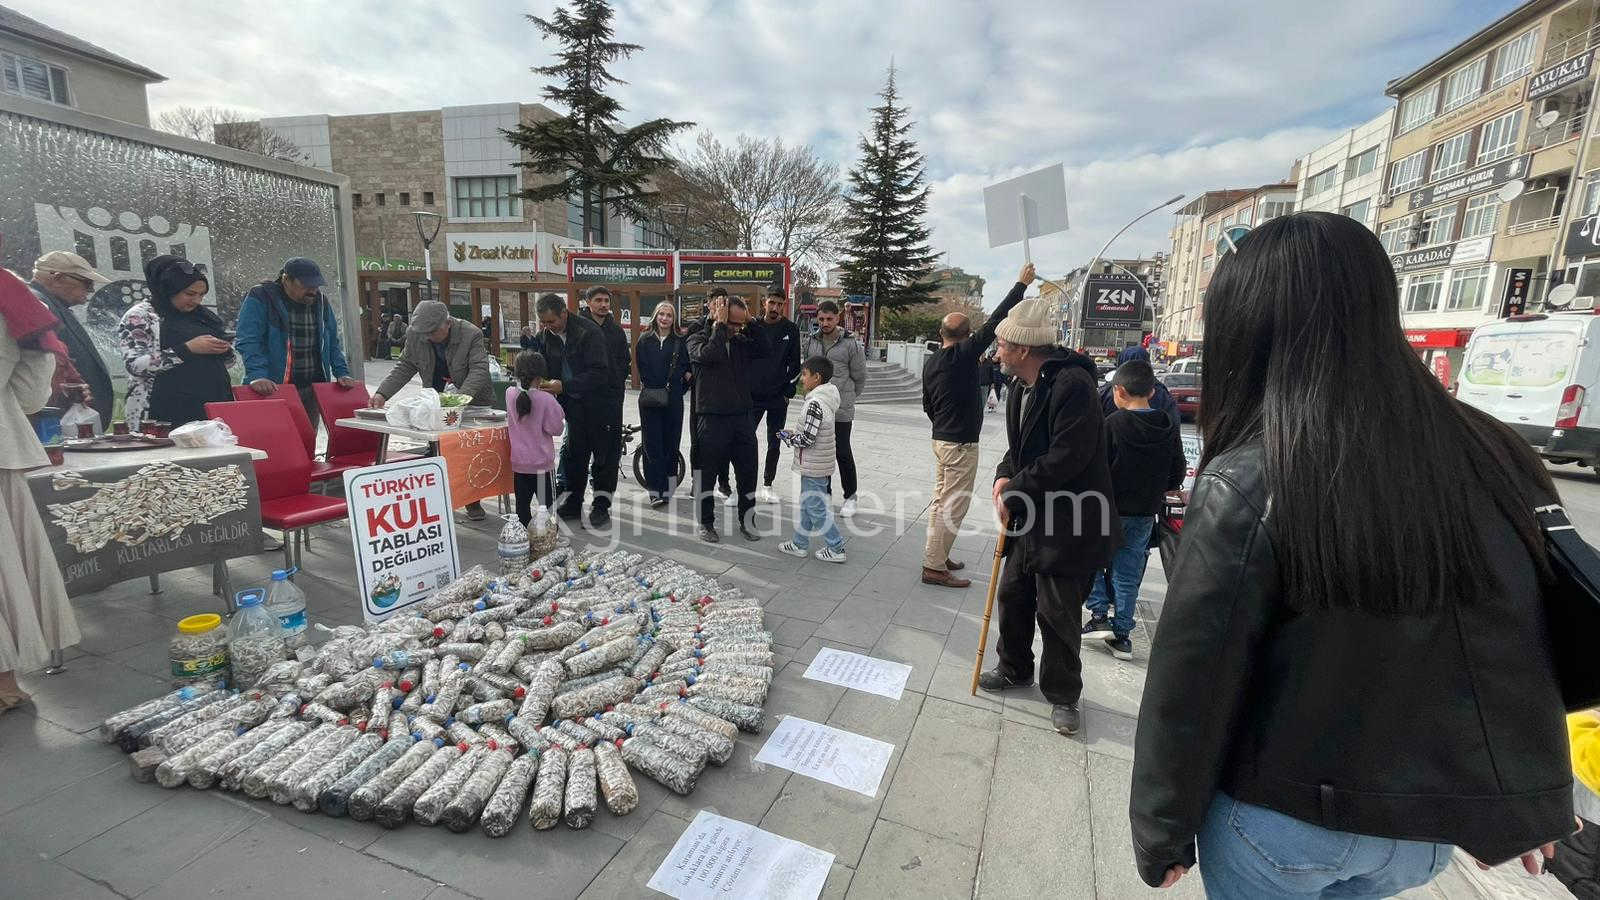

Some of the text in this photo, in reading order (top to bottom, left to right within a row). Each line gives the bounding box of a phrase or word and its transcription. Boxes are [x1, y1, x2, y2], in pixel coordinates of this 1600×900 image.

[1530, 53, 1591, 90] AVUKAT
[1405, 246, 1452, 266] KARADAĞ
[575, 263, 638, 277] ÖĞRETMENLER
[639, 265, 666, 277] GÜNÜ
[1096, 289, 1136, 304] ZEN
[361, 473, 436, 498] TÜRKİYE
[366, 493, 440, 538] KÜL
[369, 524, 442, 554] TABLASI
[372, 541, 445, 573] DEĞİLDİR!
